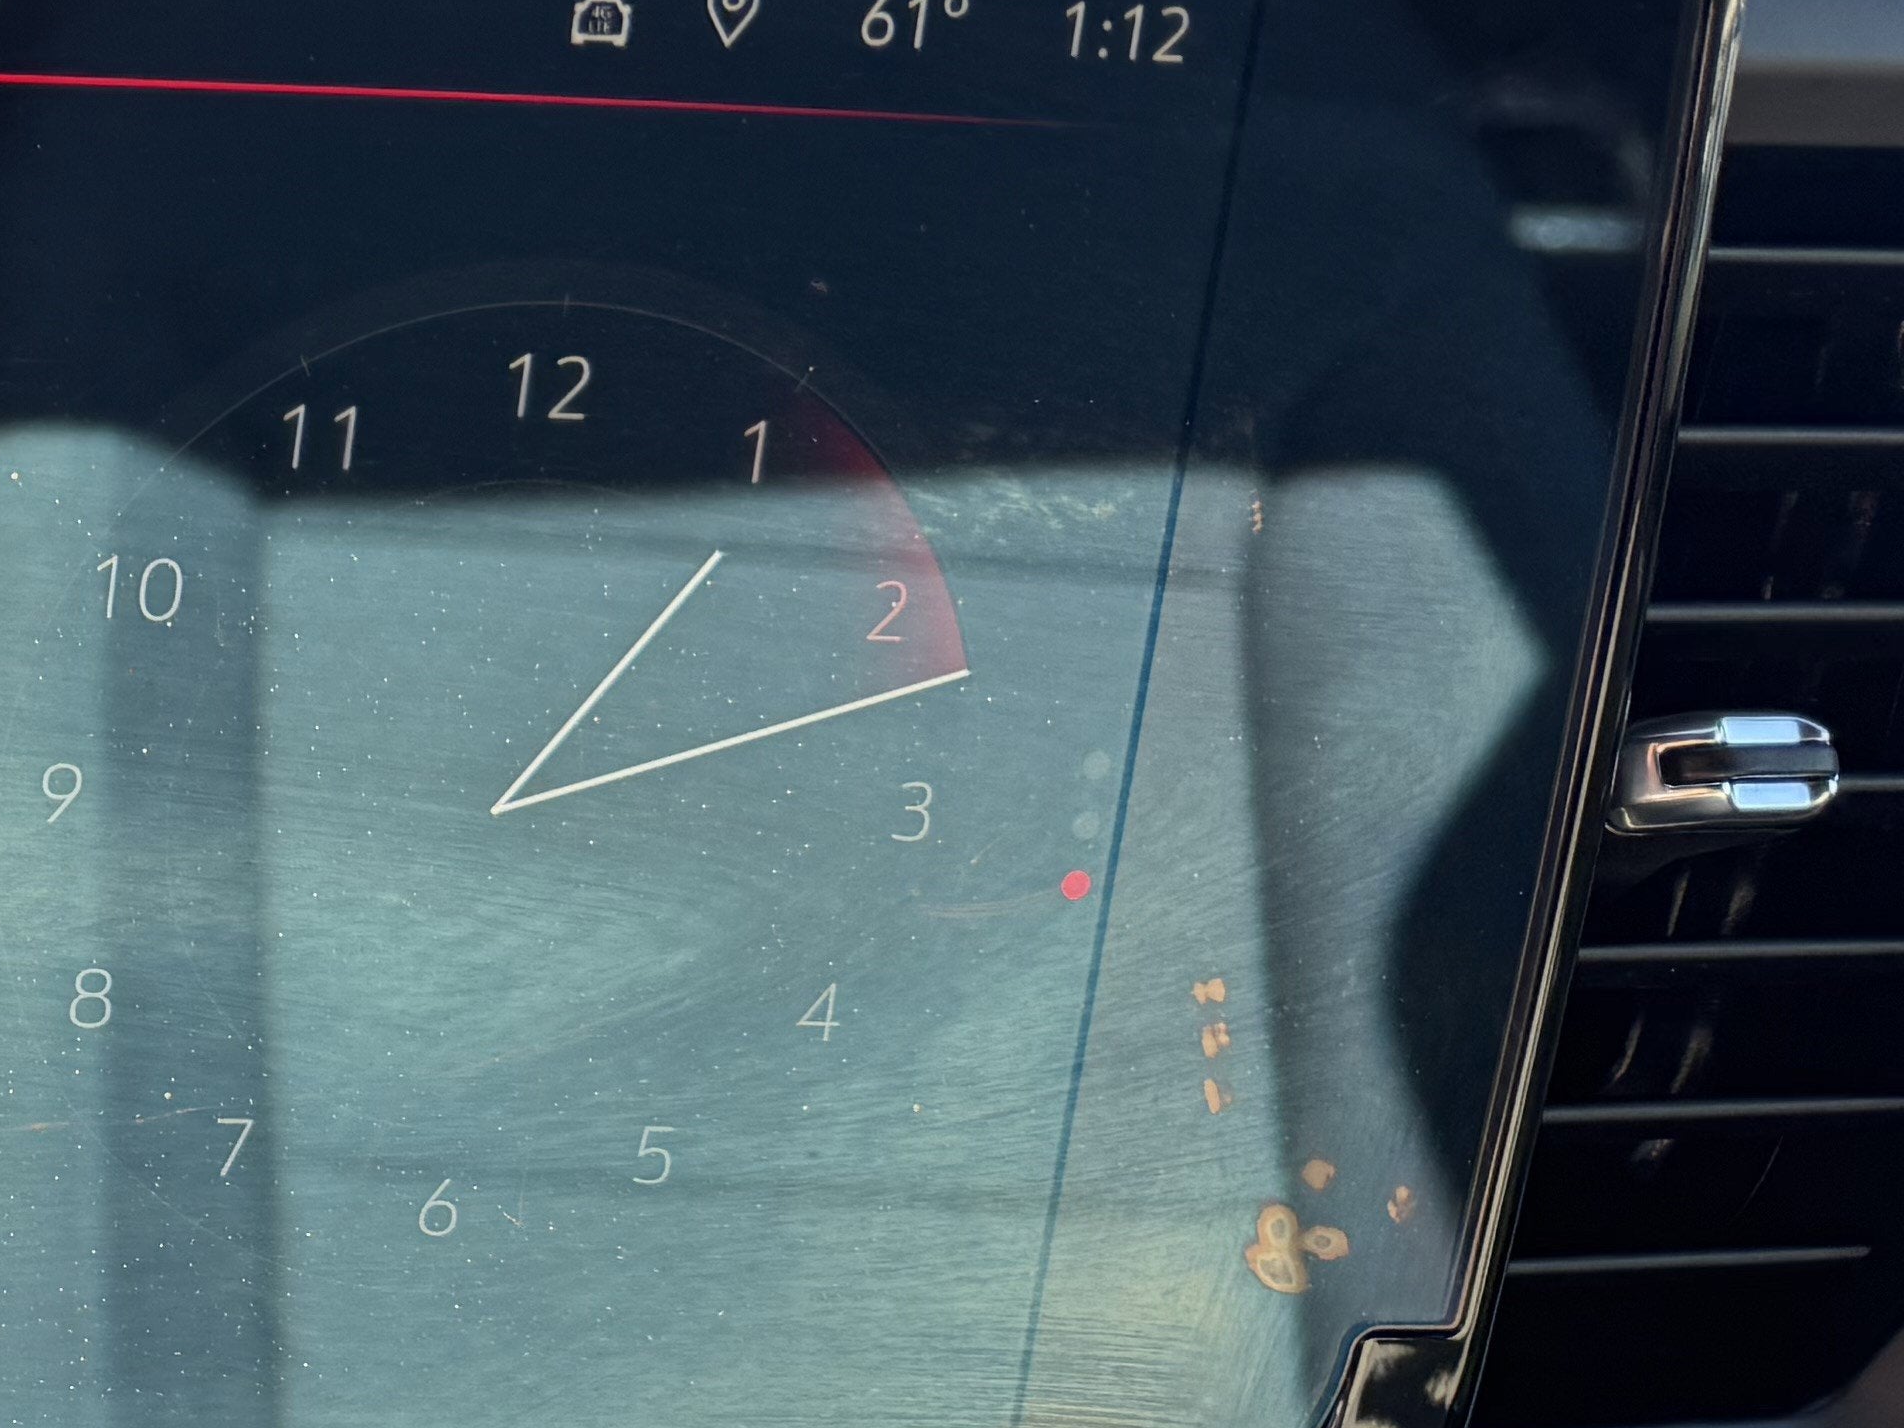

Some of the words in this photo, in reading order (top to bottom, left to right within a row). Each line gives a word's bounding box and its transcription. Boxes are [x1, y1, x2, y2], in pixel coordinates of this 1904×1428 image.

[1065, 0, 1191, 63] 1:12
[508, 353, 592, 421] 12
[282, 403, 359, 470] 11
[742, 419, 769, 484] 1
[94, 554, 185, 622] 10
[866, 580, 908, 642] 2
[40, 762, 83, 822] 9
[890, 781, 933, 843] 3
[68, 968, 115, 1028] 8
[796, 982, 842, 1042] 4
[217, 1118, 254, 1177] 7
[632, 1125, 673, 1184] 5
[418, 1178, 458, 1236] 6
